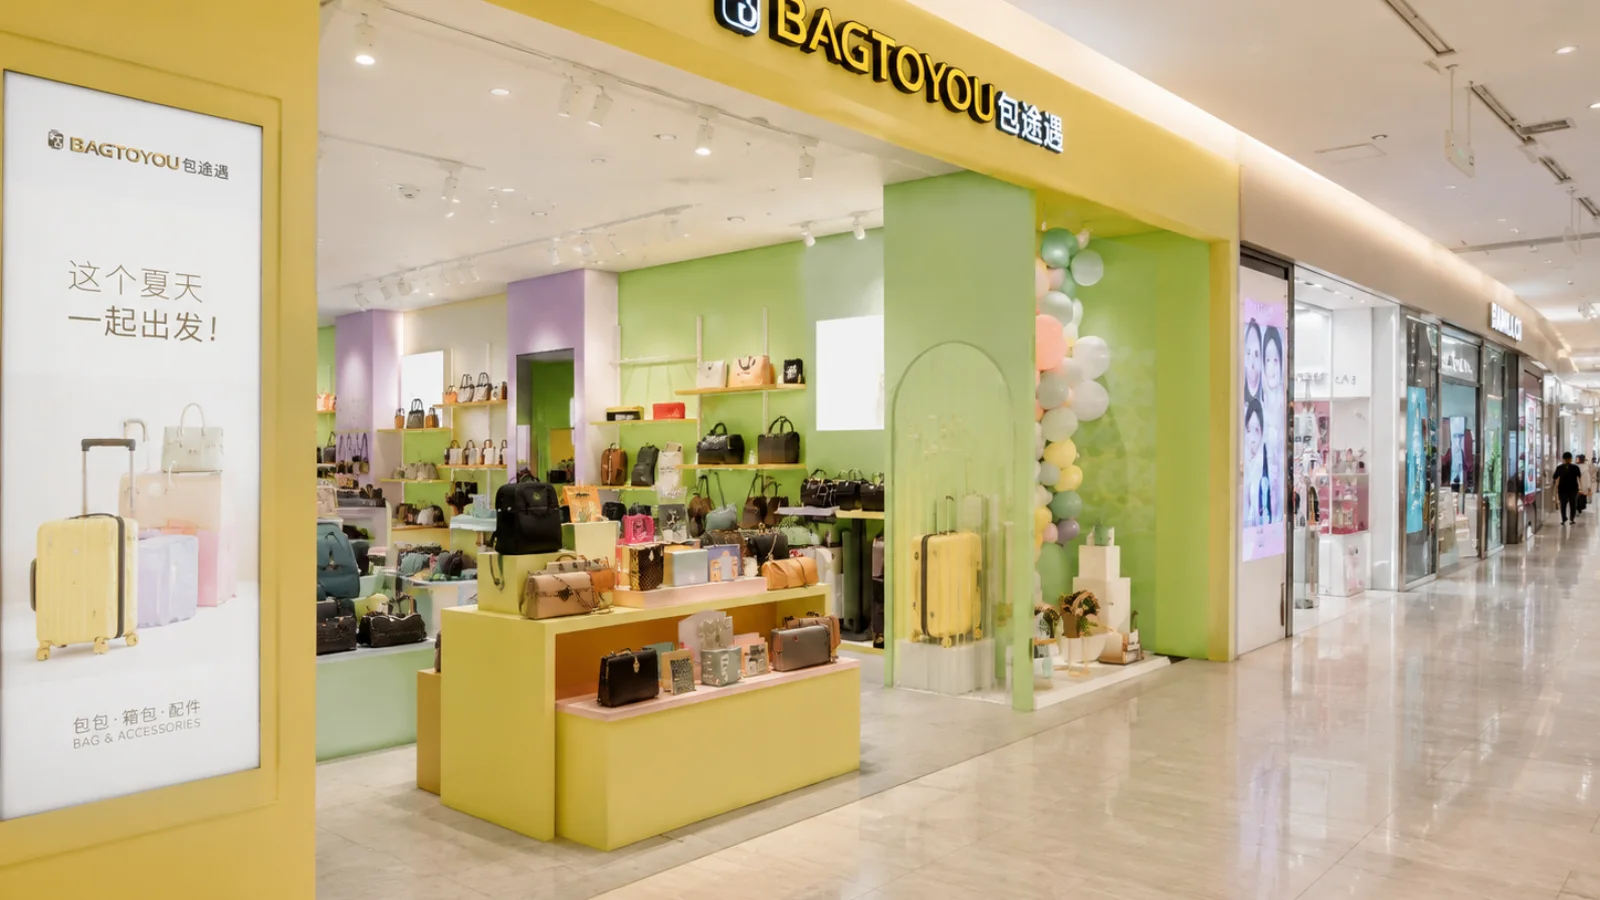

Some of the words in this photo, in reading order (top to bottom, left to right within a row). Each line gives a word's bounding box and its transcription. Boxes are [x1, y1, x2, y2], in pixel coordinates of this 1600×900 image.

[770, 0, 996, 124] BAGTOYOU
[995, 91, 1065, 154] 包途遇
[70, 136, 180, 169] BAGTOYOU
[183, 158, 229, 180] 包途遇
[68, 259, 203, 303] 这个夏天
[73, 735, 100, 749] BAG
[104, 732, 114, 744] &
[118, 718, 201, 741] ACCESSORIES
